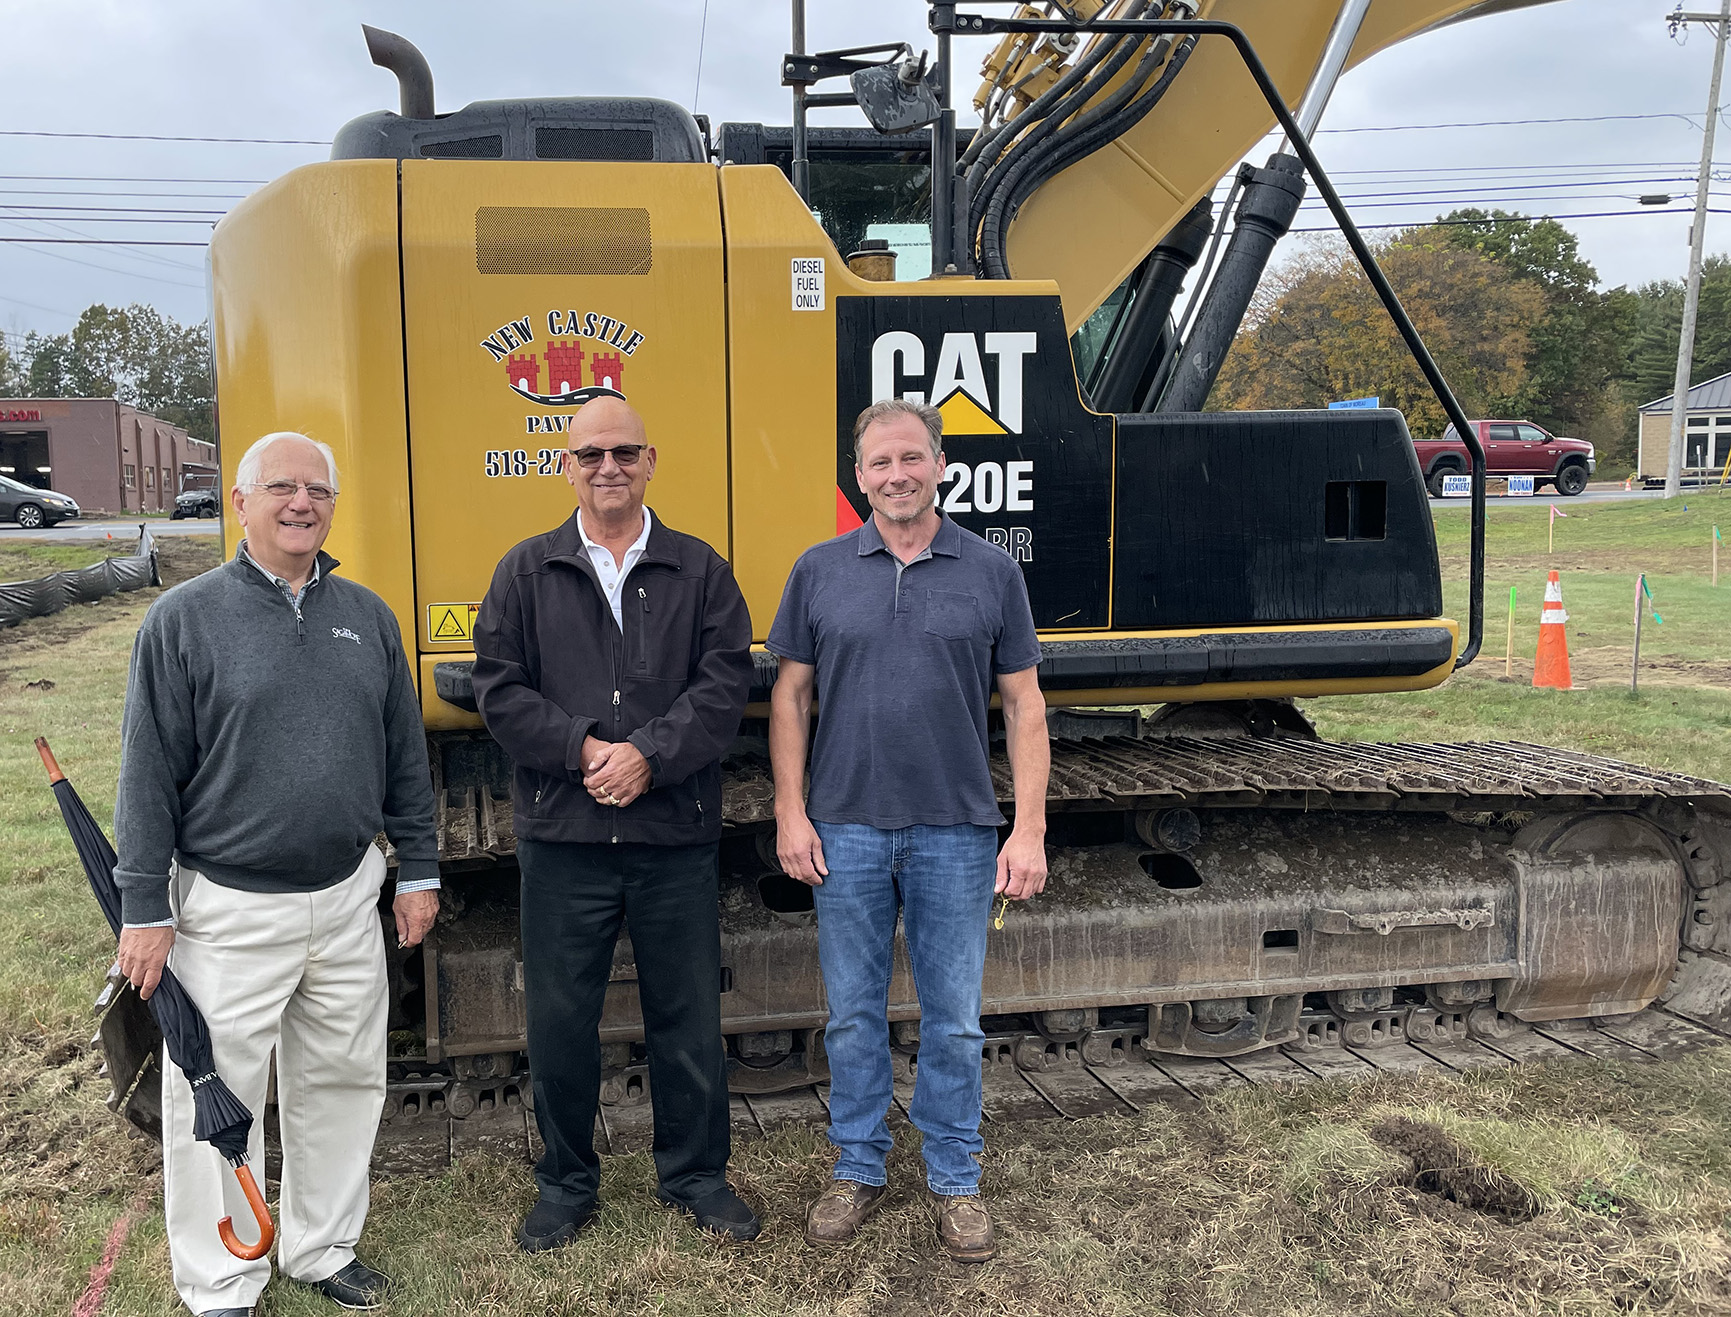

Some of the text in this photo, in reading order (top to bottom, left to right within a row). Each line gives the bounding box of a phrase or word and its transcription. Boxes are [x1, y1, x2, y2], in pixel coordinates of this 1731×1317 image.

[793, 260, 823, 273] DIESEL
[797, 277, 819, 290] FUEL
[796, 294, 820, 307] ONLY
[480, 309, 646, 362] NEW CASTLE
[872, 331, 1037, 434] CAT
[934, 461, 1033, 512] 20E
[1509, 480, 1532, 491] NOONAN
